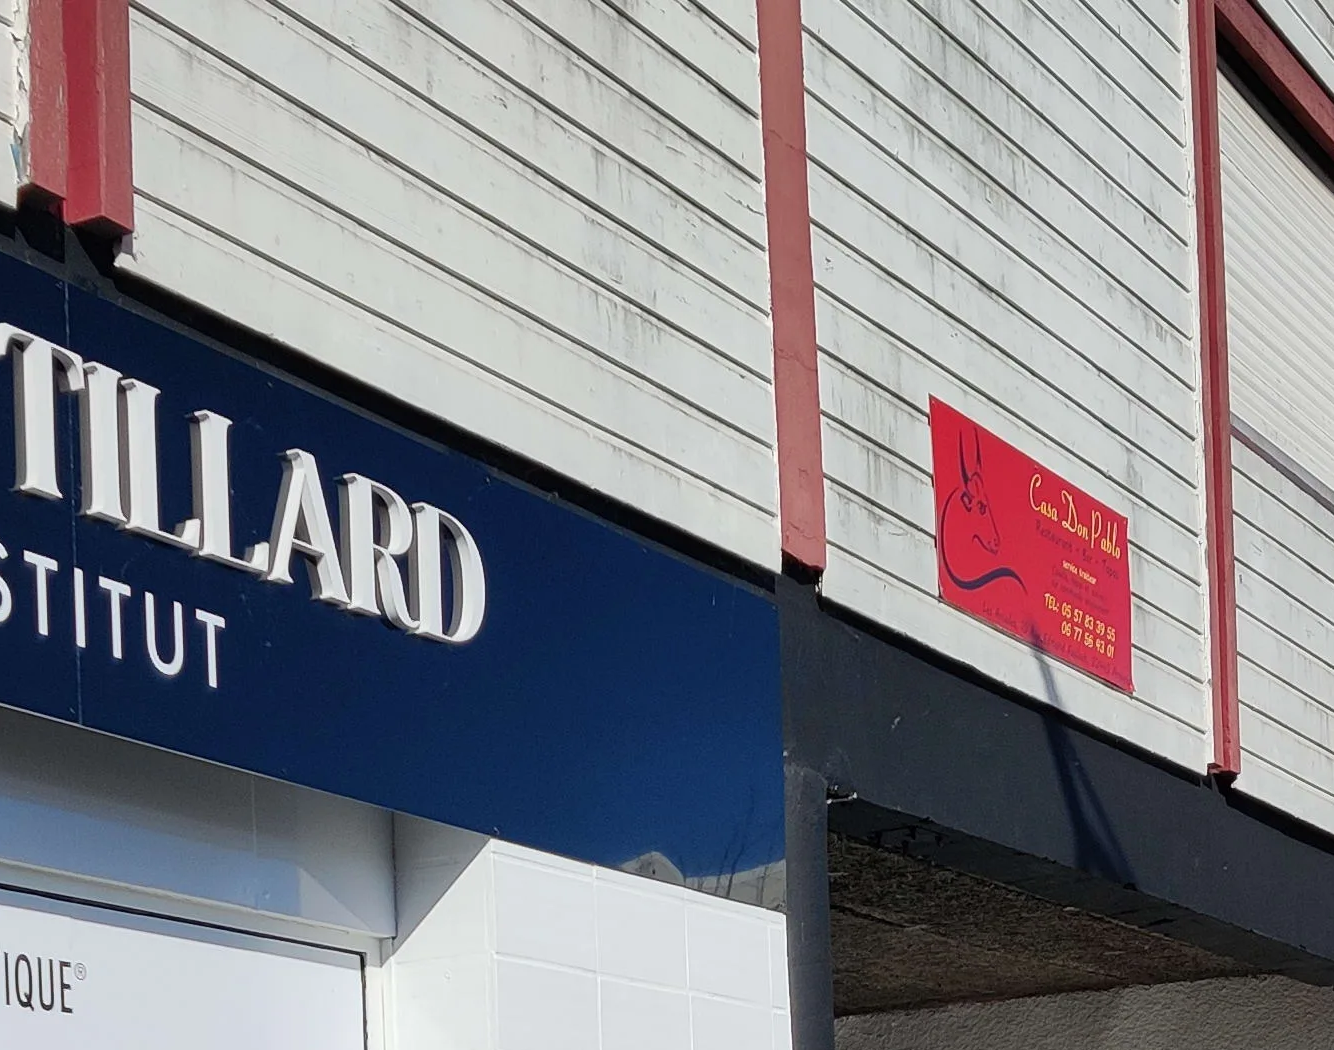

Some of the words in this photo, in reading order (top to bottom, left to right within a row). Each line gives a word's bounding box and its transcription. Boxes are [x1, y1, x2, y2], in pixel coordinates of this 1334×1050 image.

[1029, 473, 1058, 522] Casa
[1061, 490, 1088, 540] Don
[1091, 509, 1120, 559] Pablo
[1073, 609, 1083, 624] 57
[1084, 614, 1094, 630] 83
[1095, 620, 1105, 636] 39
[1106, 626, 1116, 642] 55
[1073, 626, 1083, 642] 77
[1106, 644, 1115, 659] 01
